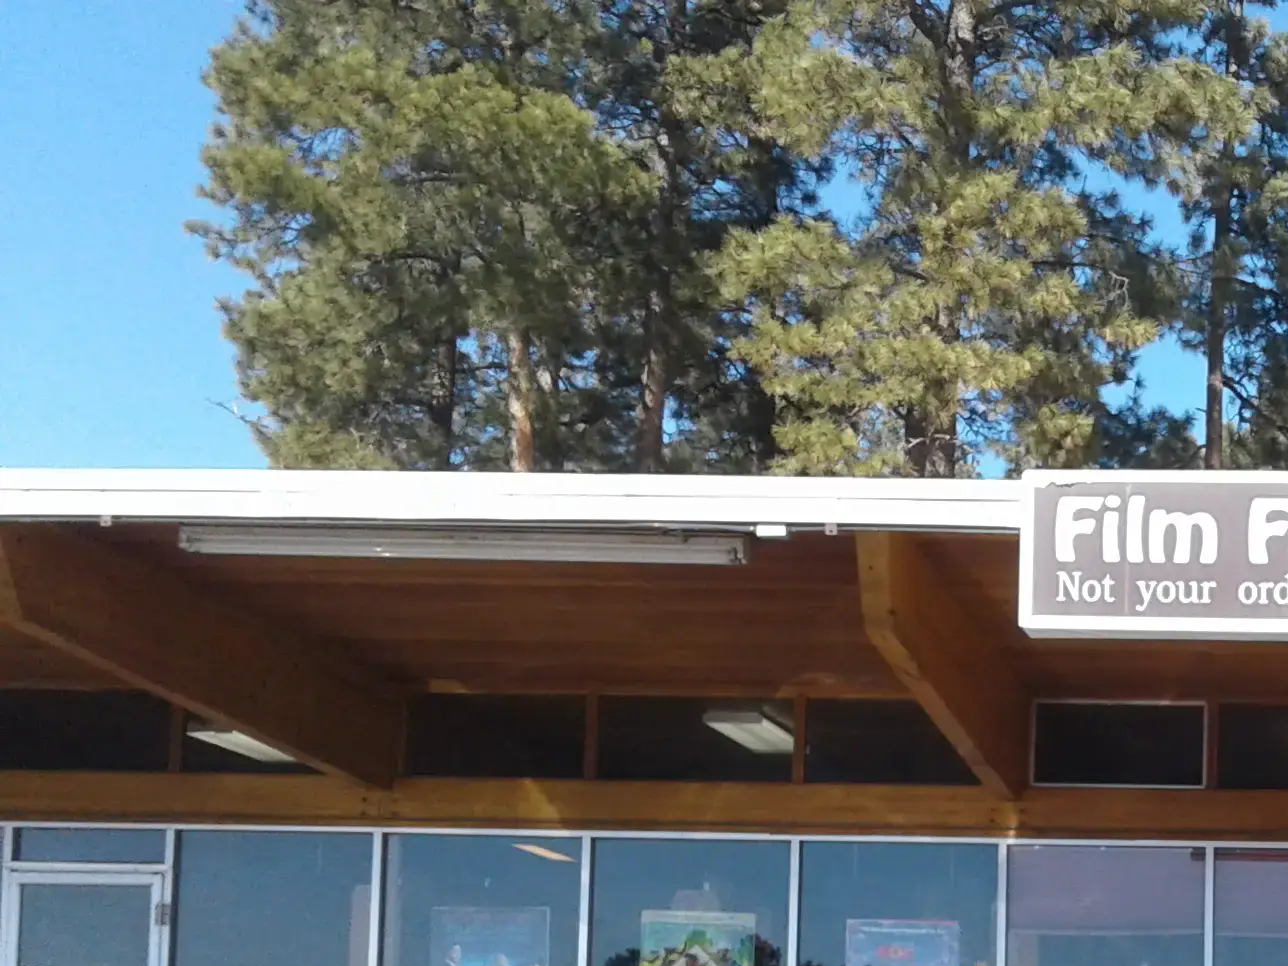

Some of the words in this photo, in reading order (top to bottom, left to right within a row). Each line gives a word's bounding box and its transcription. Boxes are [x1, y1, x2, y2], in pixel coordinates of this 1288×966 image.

[1054, 495, 1219, 565] Film
[1055, 570, 1116, 604] Not
[1135, 580, 1217, 614] your
